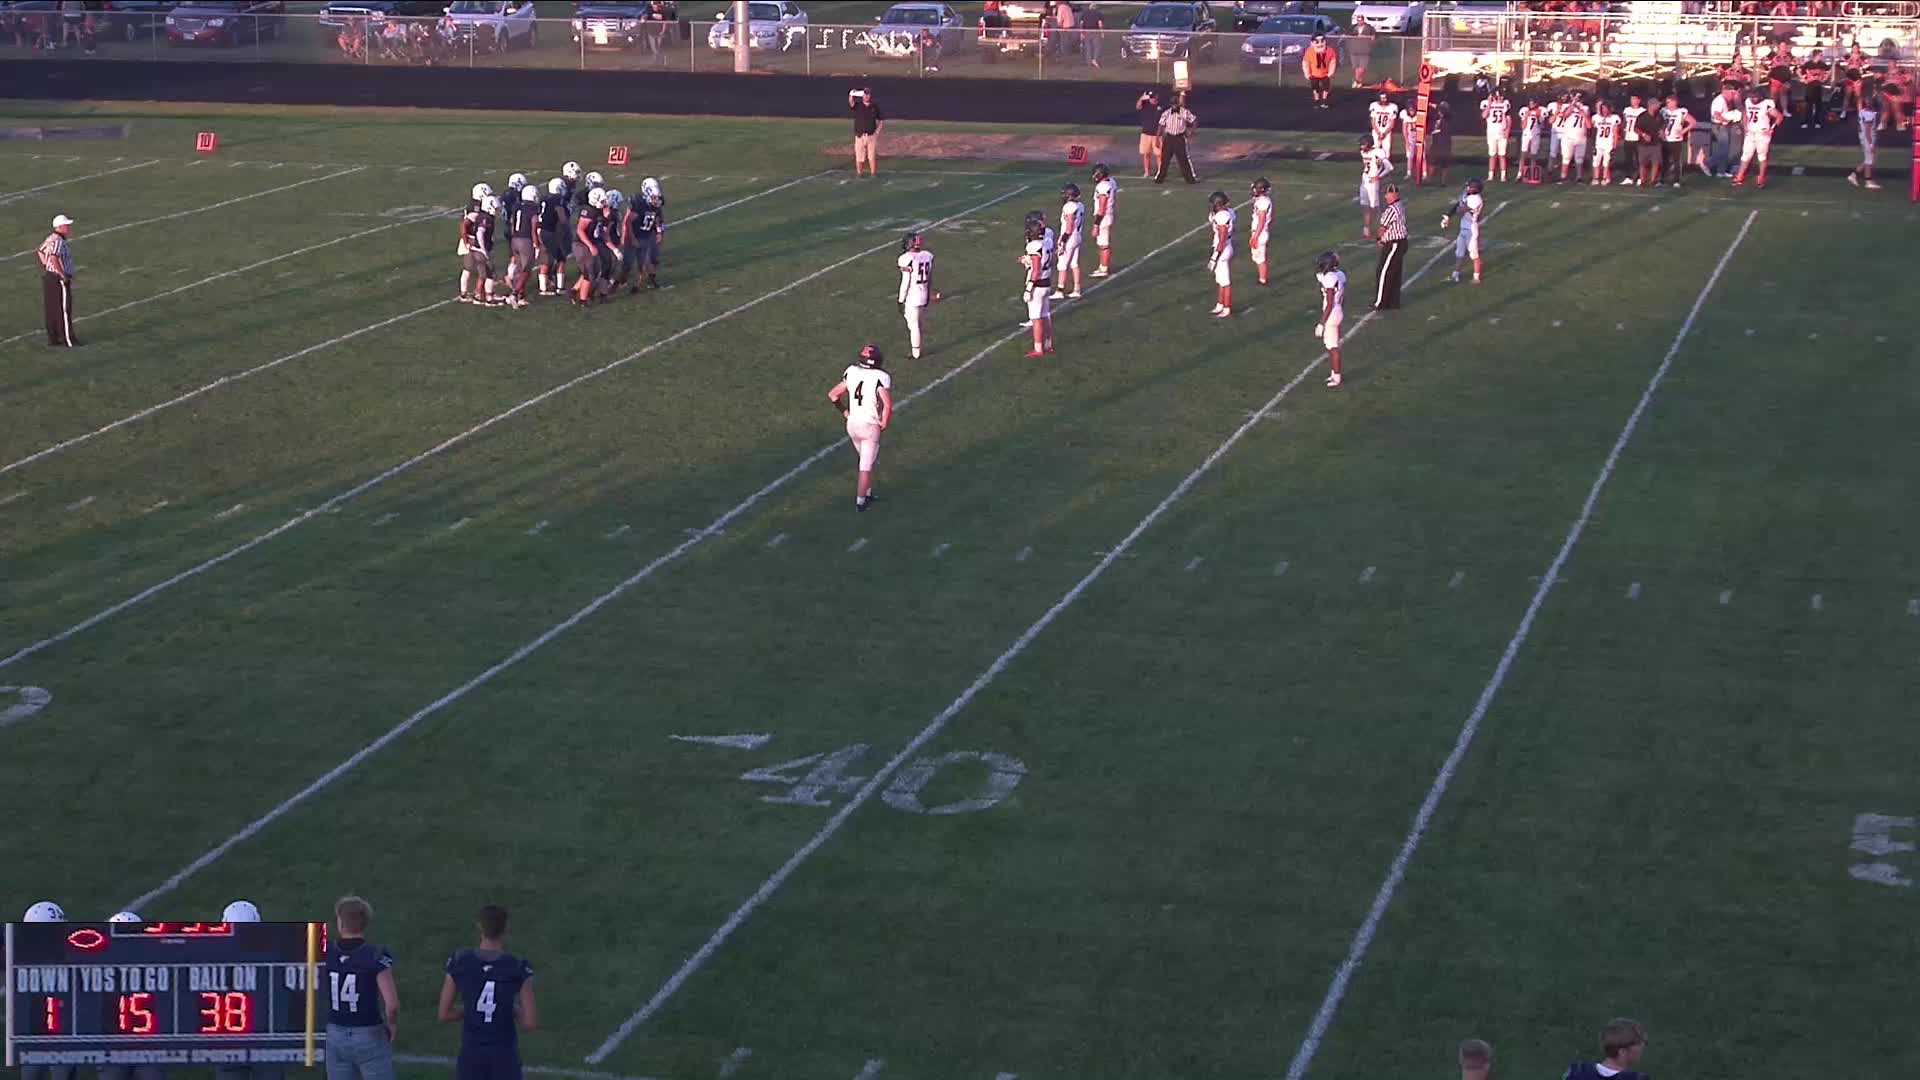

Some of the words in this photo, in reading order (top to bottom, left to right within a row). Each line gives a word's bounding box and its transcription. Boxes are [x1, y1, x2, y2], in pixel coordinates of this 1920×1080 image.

[1492, 110, 1503, 123] 53
[610, 147, 625, 161] 20
[1069, 145, 1085, 160] 30
[854, 381, 864, 406] 4
[740, 744, 1028, 815] 40
[329, 971, 360, 1012] 14
[476, 980, 497, 1023] 4
